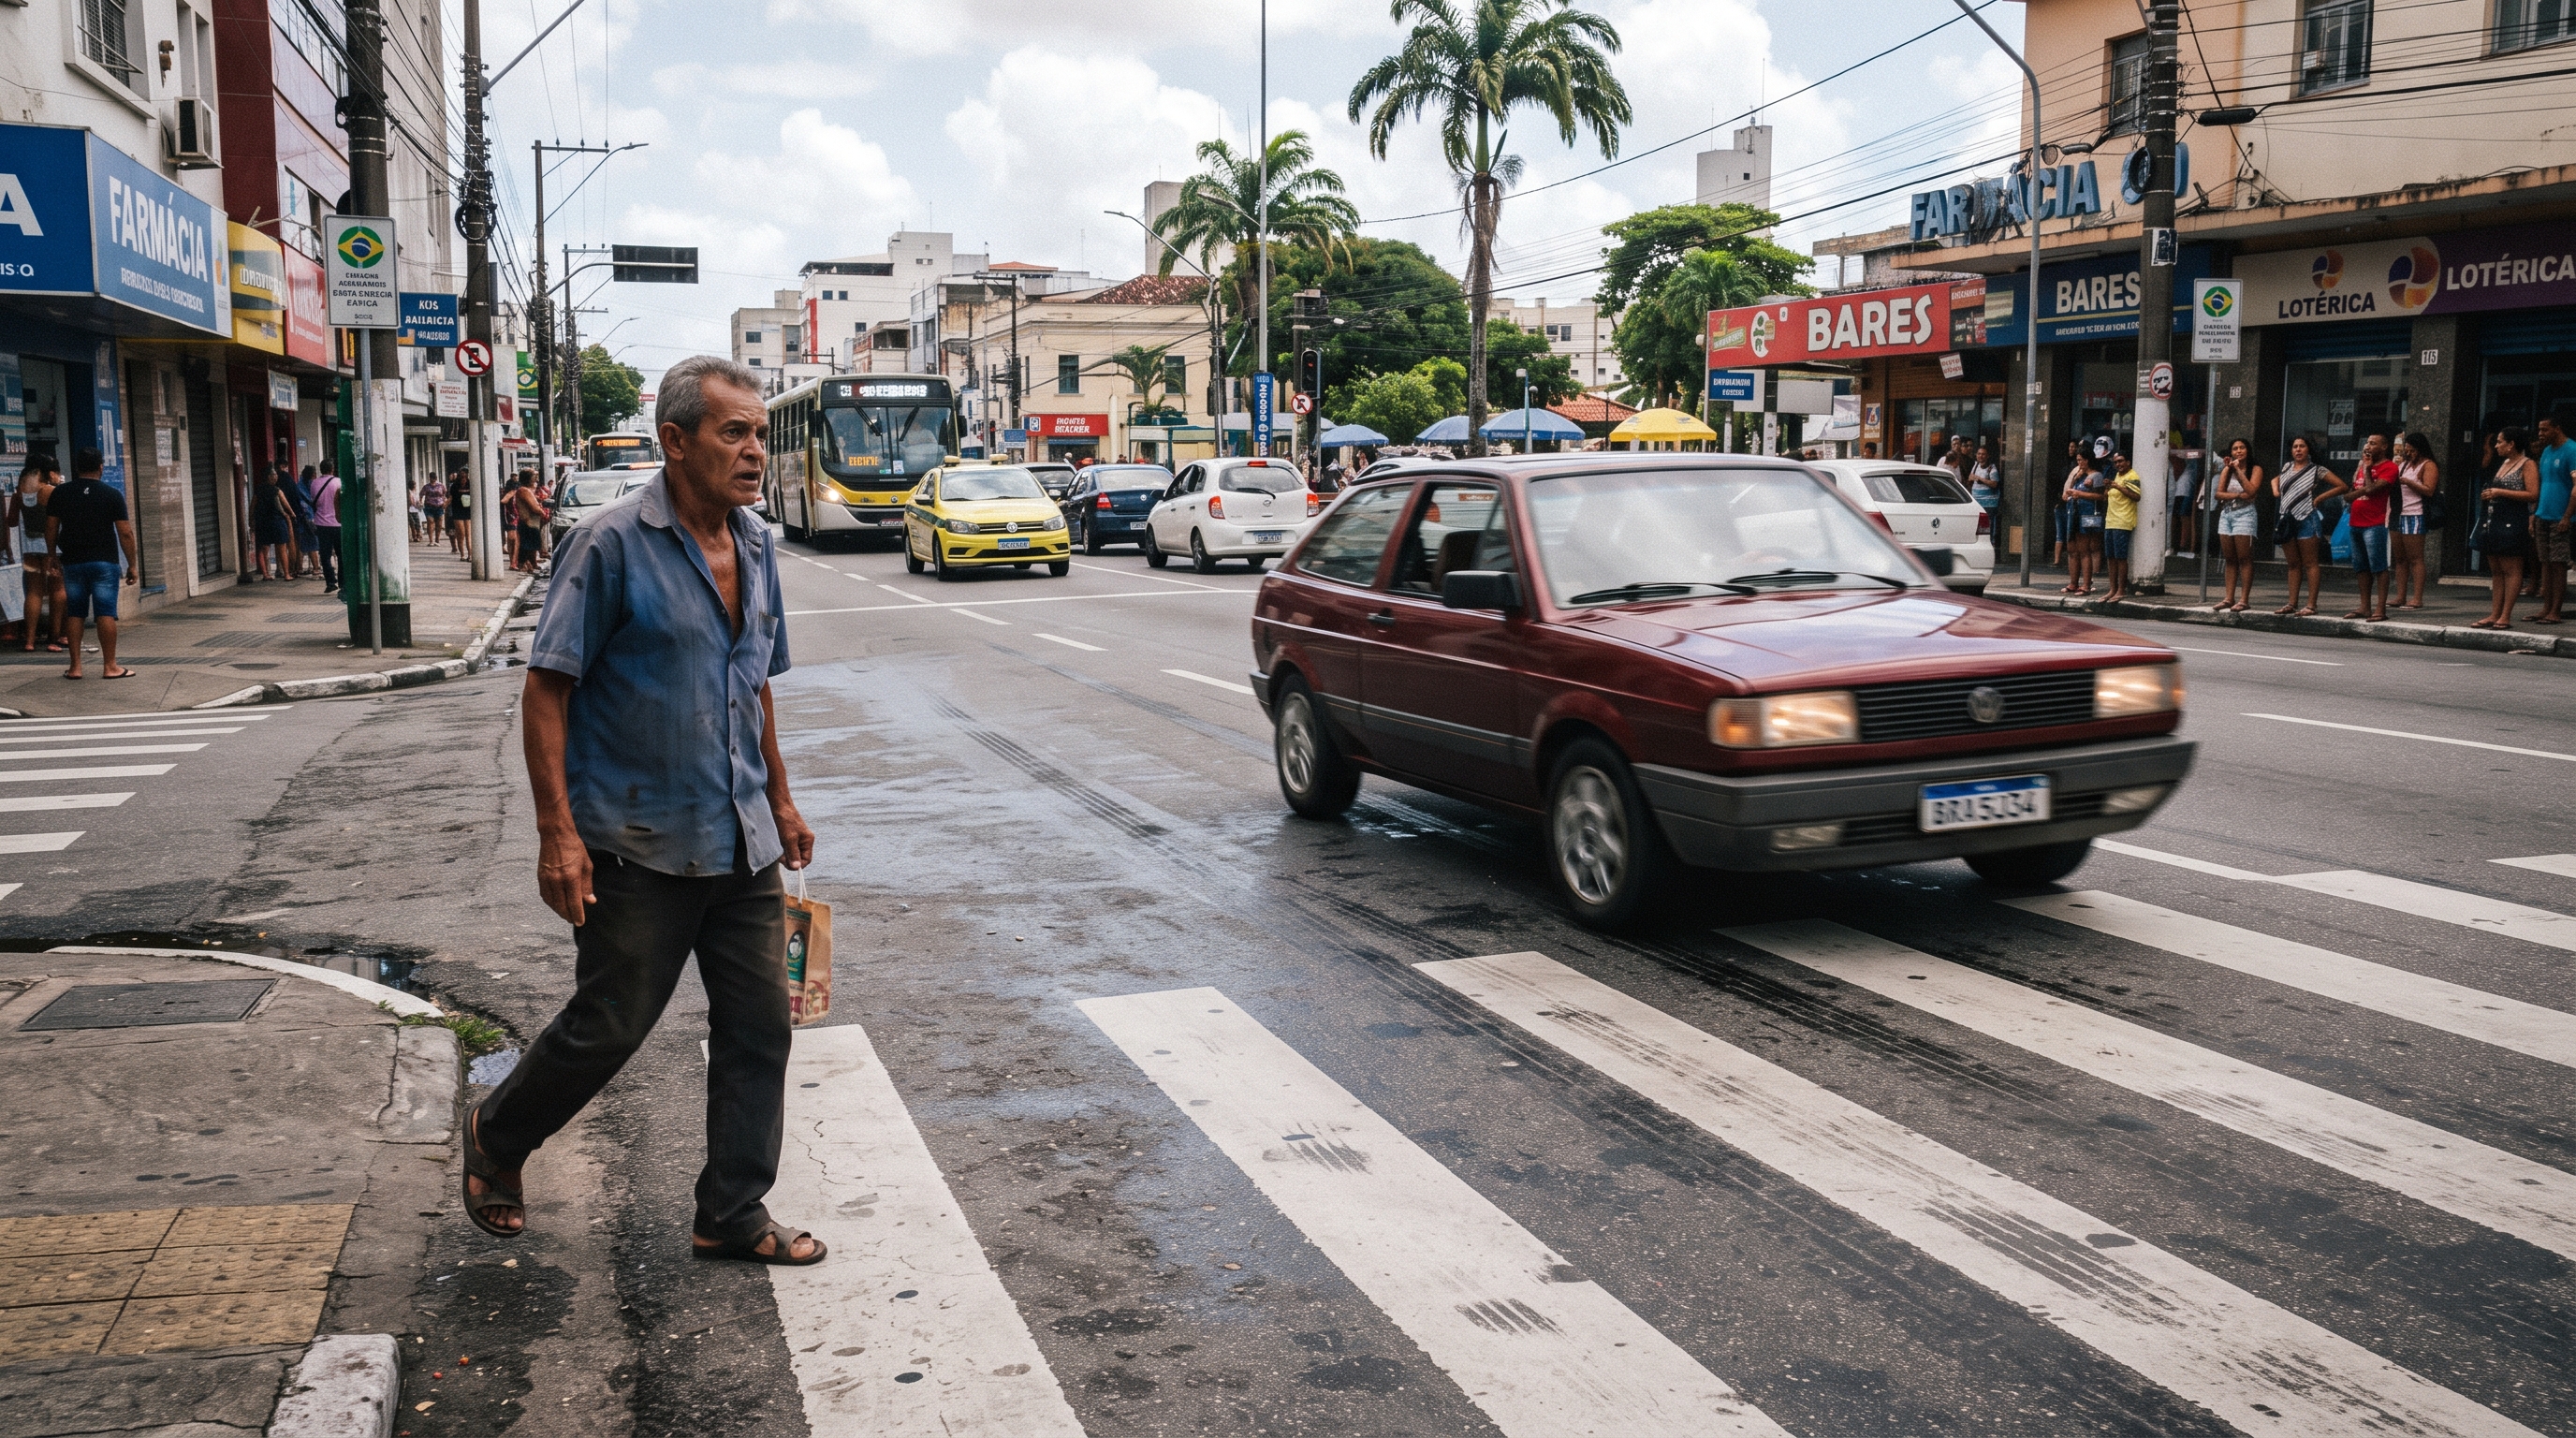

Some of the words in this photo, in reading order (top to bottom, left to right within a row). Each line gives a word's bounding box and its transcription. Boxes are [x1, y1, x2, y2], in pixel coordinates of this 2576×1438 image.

[109, 175, 208, 283] FARMÁCIA
[2056, 271, 2141, 315] BARES
[2445, 252, 2576, 290] LOTÉRICA
[1807, 293, 1934, 353] BARES
[2277, 291, 2376, 319] LOTÉRICA
